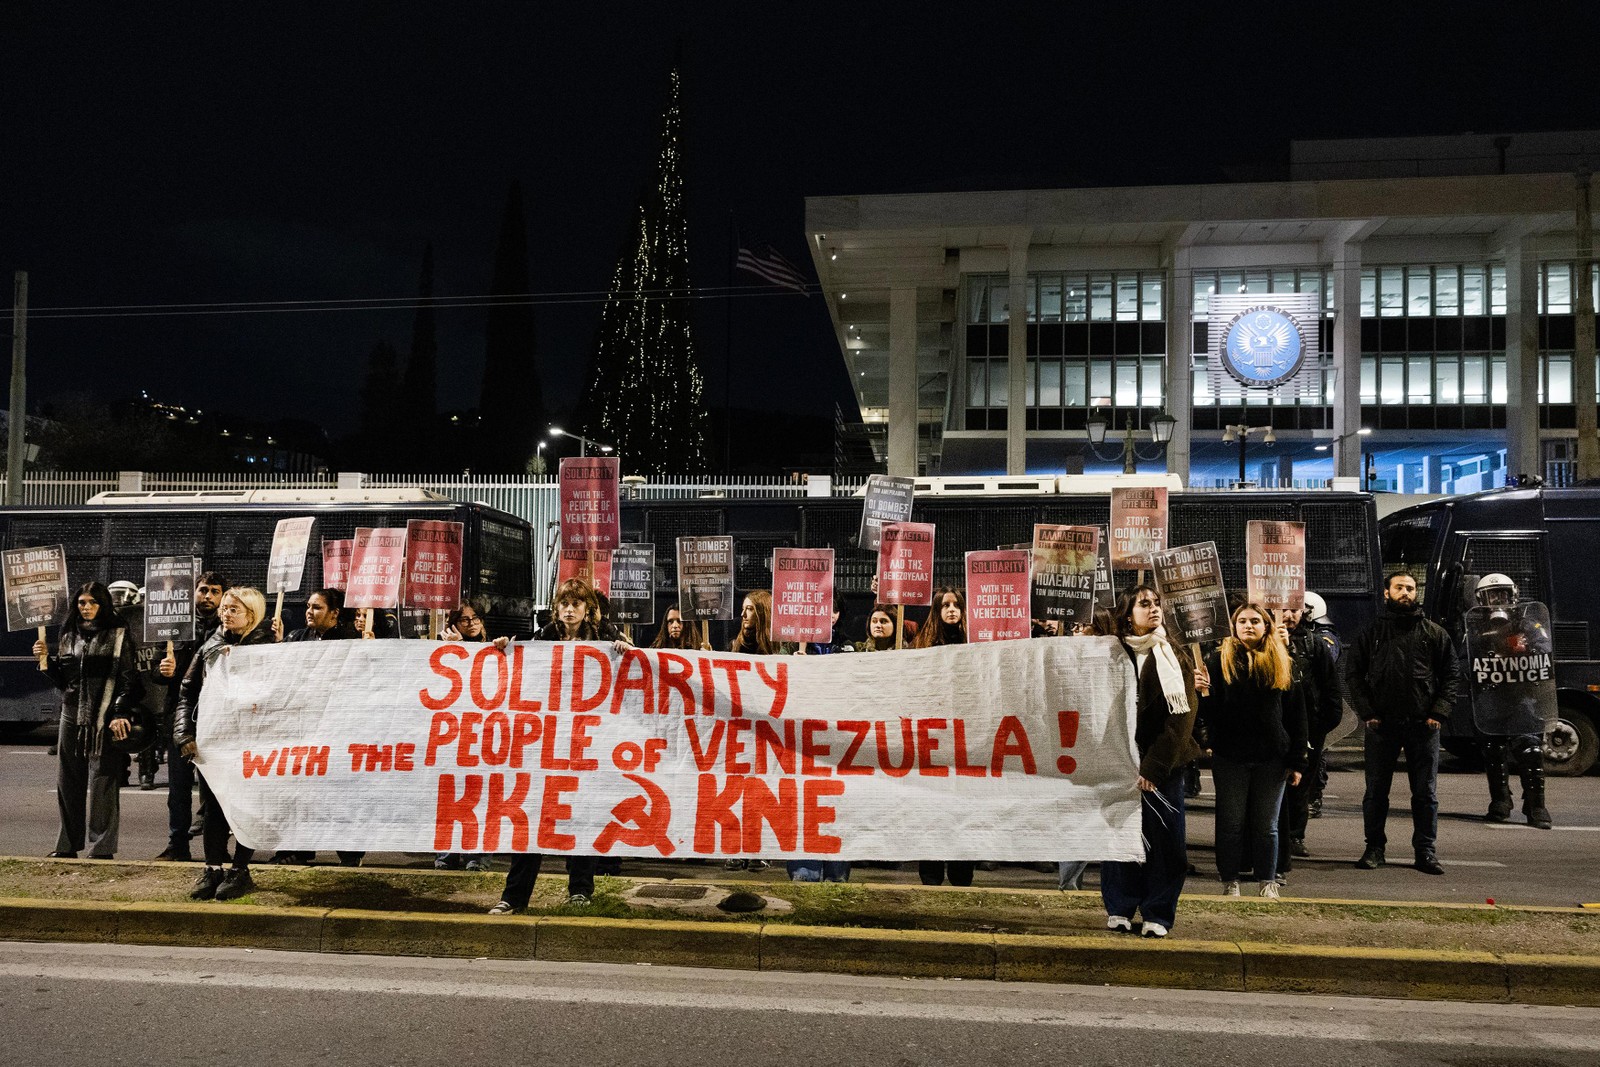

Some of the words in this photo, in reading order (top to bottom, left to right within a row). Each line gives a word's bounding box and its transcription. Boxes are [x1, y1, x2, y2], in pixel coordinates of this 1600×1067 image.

[1242, 376, 1284, 386] EMBASSY
[565, 468, 614, 479] SOLIDARITY
[573, 491, 590, 499] WITH
[593, 490, 604, 499] THE
[570, 501, 598, 510] PEOPLE
[600, 502, 610, 511] OF
[869, 499, 875, 509] ΟΙ
[878, 501, 909, 513] ΒΟΜΒΕΣ
[566, 513, 614, 524] VENEZUELA!
[1126, 517, 1150, 525] ΣΤΟΥΣ
[412, 531, 459, 543] SOLIDARITY
[1042, 531, 1091, 542] ΑΛΛΗΛΕΓΓΥΗ
[1115, 528, 1163, 539] ΦΟΝΙΑΔΕΣ
[682, 542, 695, 552] ΤΙΣ
[698, 541, 729, 551] ΒΟΜΒΕΣ
[1117, 541, 1133, 551] ΤΩΝ
[7, 554, 21, 564] ΤΙΣ
[24, 549, 60, 562] ΒΟΜΒΕΣ
[437, 552, 448, 560] THE
[685, 554, 698, 564] ΤΙΣ
[701, 553, 726, 563] ΡΙΧΝΕΙ
[900, 549, 912, 557] ΣΤΟ
[1156, 555, 1173, 567] ΤΙΣ
[1174, 547, 1213, 564] ΒΟΜΒΕΣ
[1264, 553, 1288, 562] ΣΤΟΥΣ
[11, 565, 25, 575] ΤΙΣ
[28, 561, 58, 573] ΡΙΧΝΕΙ
[359, 565, 382, 573] PEOPLE
[386, 565, 395, 574] OF
[415, 561, 441, 571] PEOPLE
[444, 563, 453, 572] OF
[780, 559, 829, 570] SOLIDARITY
[890, 560, 905, 570] ΛΑΟ
[908, 560, 922, 570] ΤΗΣ
[972, 561, 1024, 573] SOLIDARITY
[619, 570, 651, 581] ΒΟΜΒΕΣ
[883, 572, 928, 581] ΒΕΝΕΖΟΥΕΛΑΣ
[1162, 568, 1179, 581] ΤΙΣ
[1181, 562, 1212, 578] ΡΙΧΝΕΙ
[1253, 565, 1301, 577] ΦΟΝΙΑΔΕΣ
[353, 575, 397, 585] VENEZUELA!
[410, 574, 456, 585] VENEZUELA!
[1036, 573, 1090, 589] ΠΟΛΕΜΟΥΣ
[1256, 579, 1272, 590] ΤΩΝ
[787, 582, 804, 590] WITH
[806, 582, 818, 590] THE
[150, 590, 189, 601] ΦΟΝΙΑΔΕΣ
[782, 592, 811, 602] PEOPLE
[814, 592, 824, 603] OF
[977, 595, 1007, 605] PEOPLE
[1010, 595, 1020, 605] OF
[148, 603, 163, 615] ΤΩΝ
[166, 602, 190, 615] ΛΑΩΝ
[778, 605, 828, 616] VENEZUELA!
[973, 608, 1026, 619] VENEZUELA!
[1047, 607, 1065, 615] ΚΝΕ
[26, 615, 43, 623] ΚΝΕ
[1185, 629, 1204, 638] ΚΝΕ
[1473, 654, 1551, 672] ΑΣΤΥΝΟΜΙΑ
[419, 644, 788, 718] SOLIDARITY
[1477, 668, 1549, 683] POLICE
[242, 745, 330, 779] WITH
[348, 742, 416, 772] THE
[424, 711, 602, 771] PEOPLE
[612, 738, 668, 773] OF
[434, 772, 579, 852] KKE
[693, 773, 845, 854] KNE
